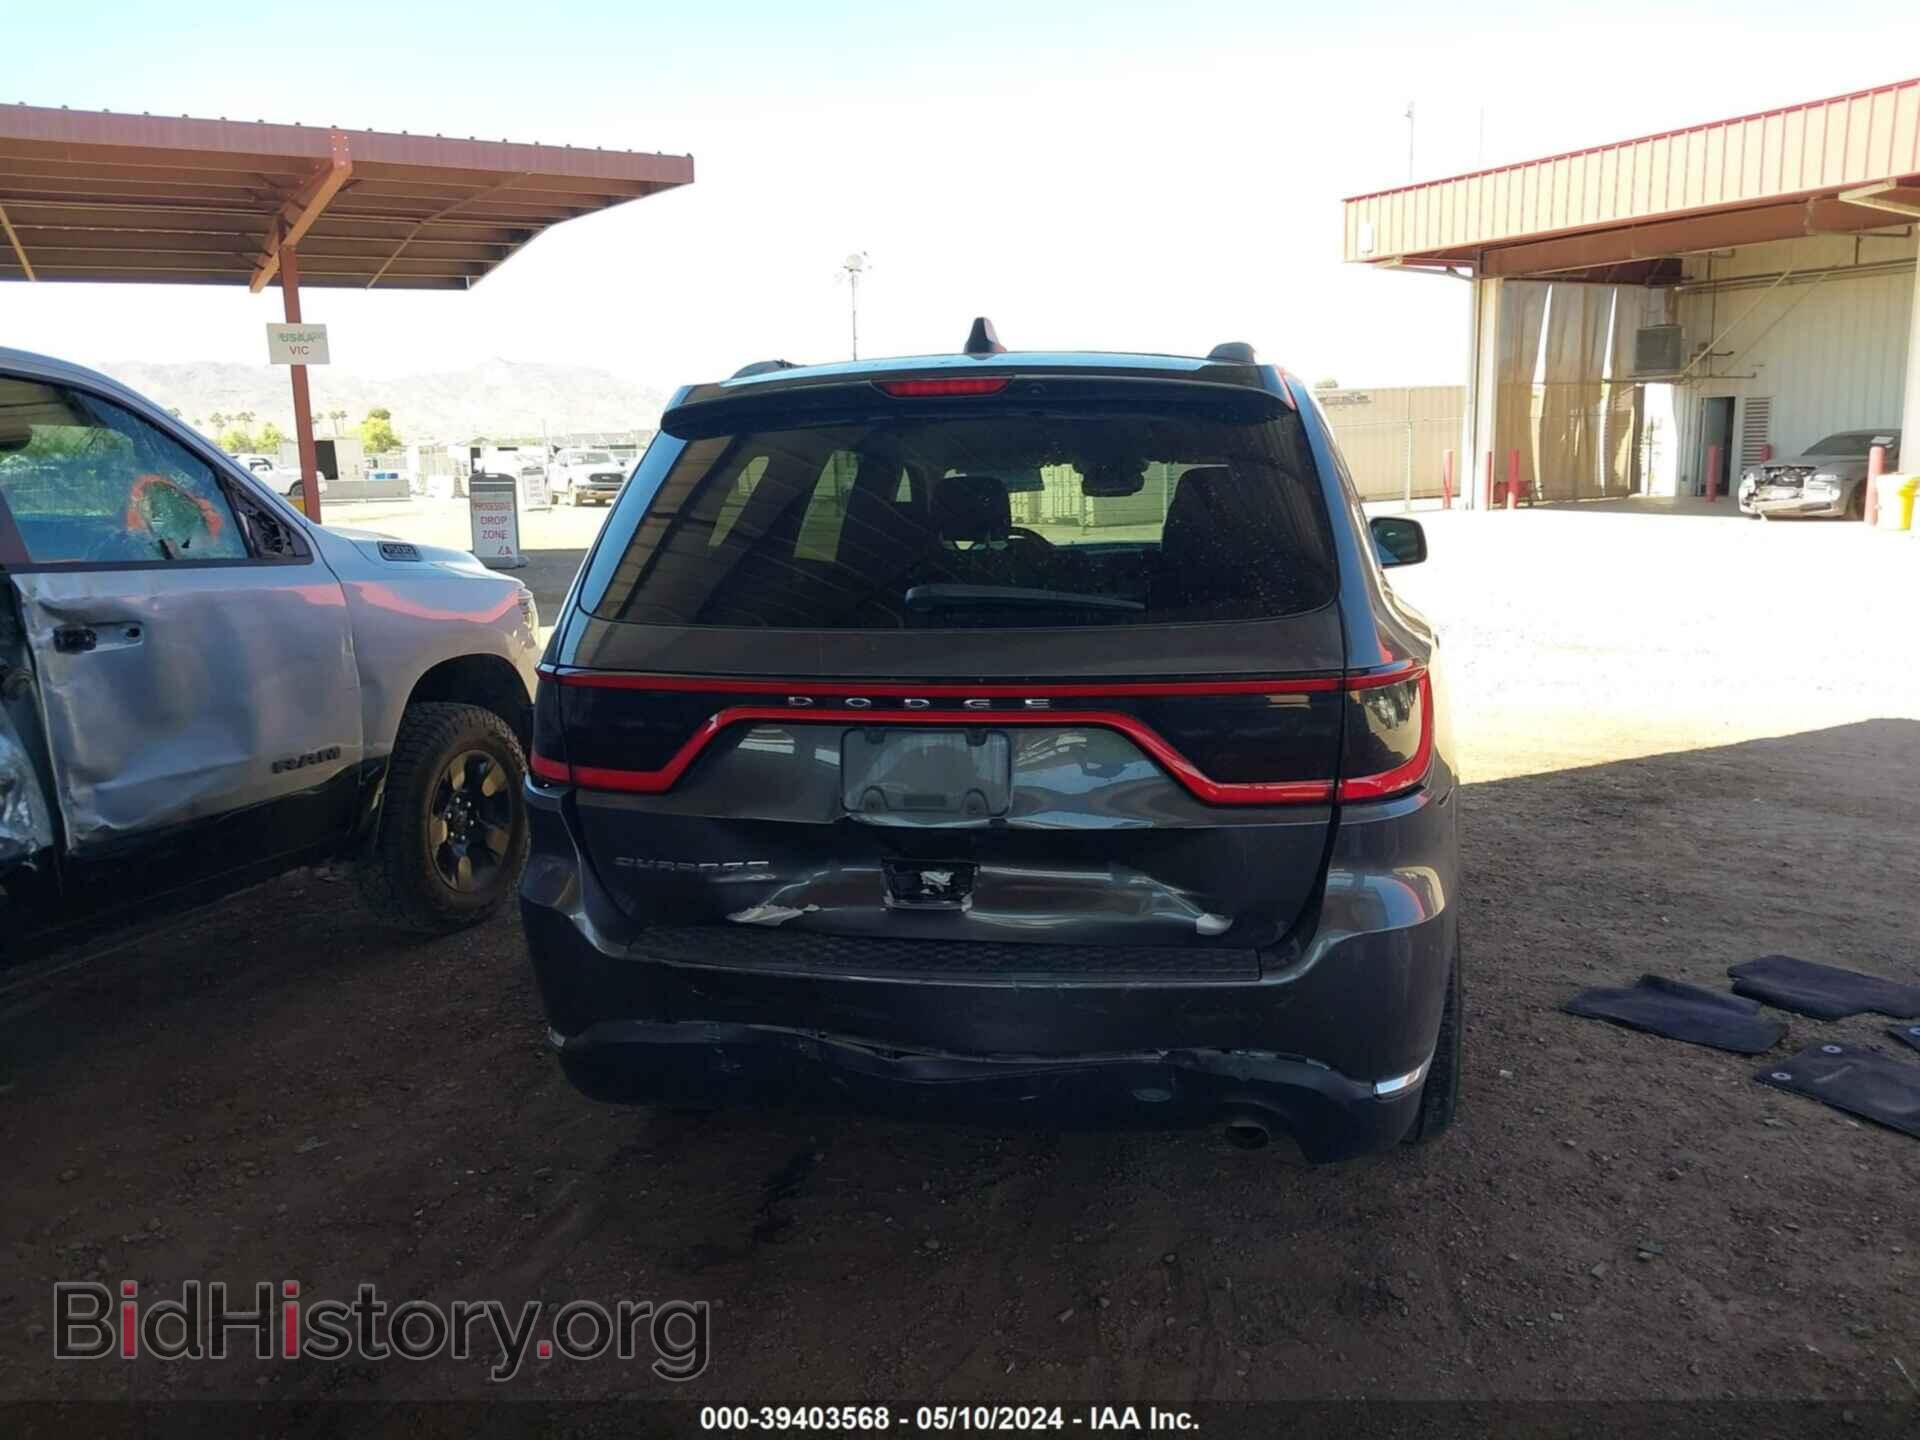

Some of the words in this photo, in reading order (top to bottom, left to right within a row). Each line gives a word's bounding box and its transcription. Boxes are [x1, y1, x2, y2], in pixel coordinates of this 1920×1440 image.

[289, 345, 311, 355] VIC
[480, 515, 507, 525] DROP
[481, 529, 509, 540] ZONE
[788, 696, 1050, 709] DODGE
[271, 745, 341, 774] RAM
